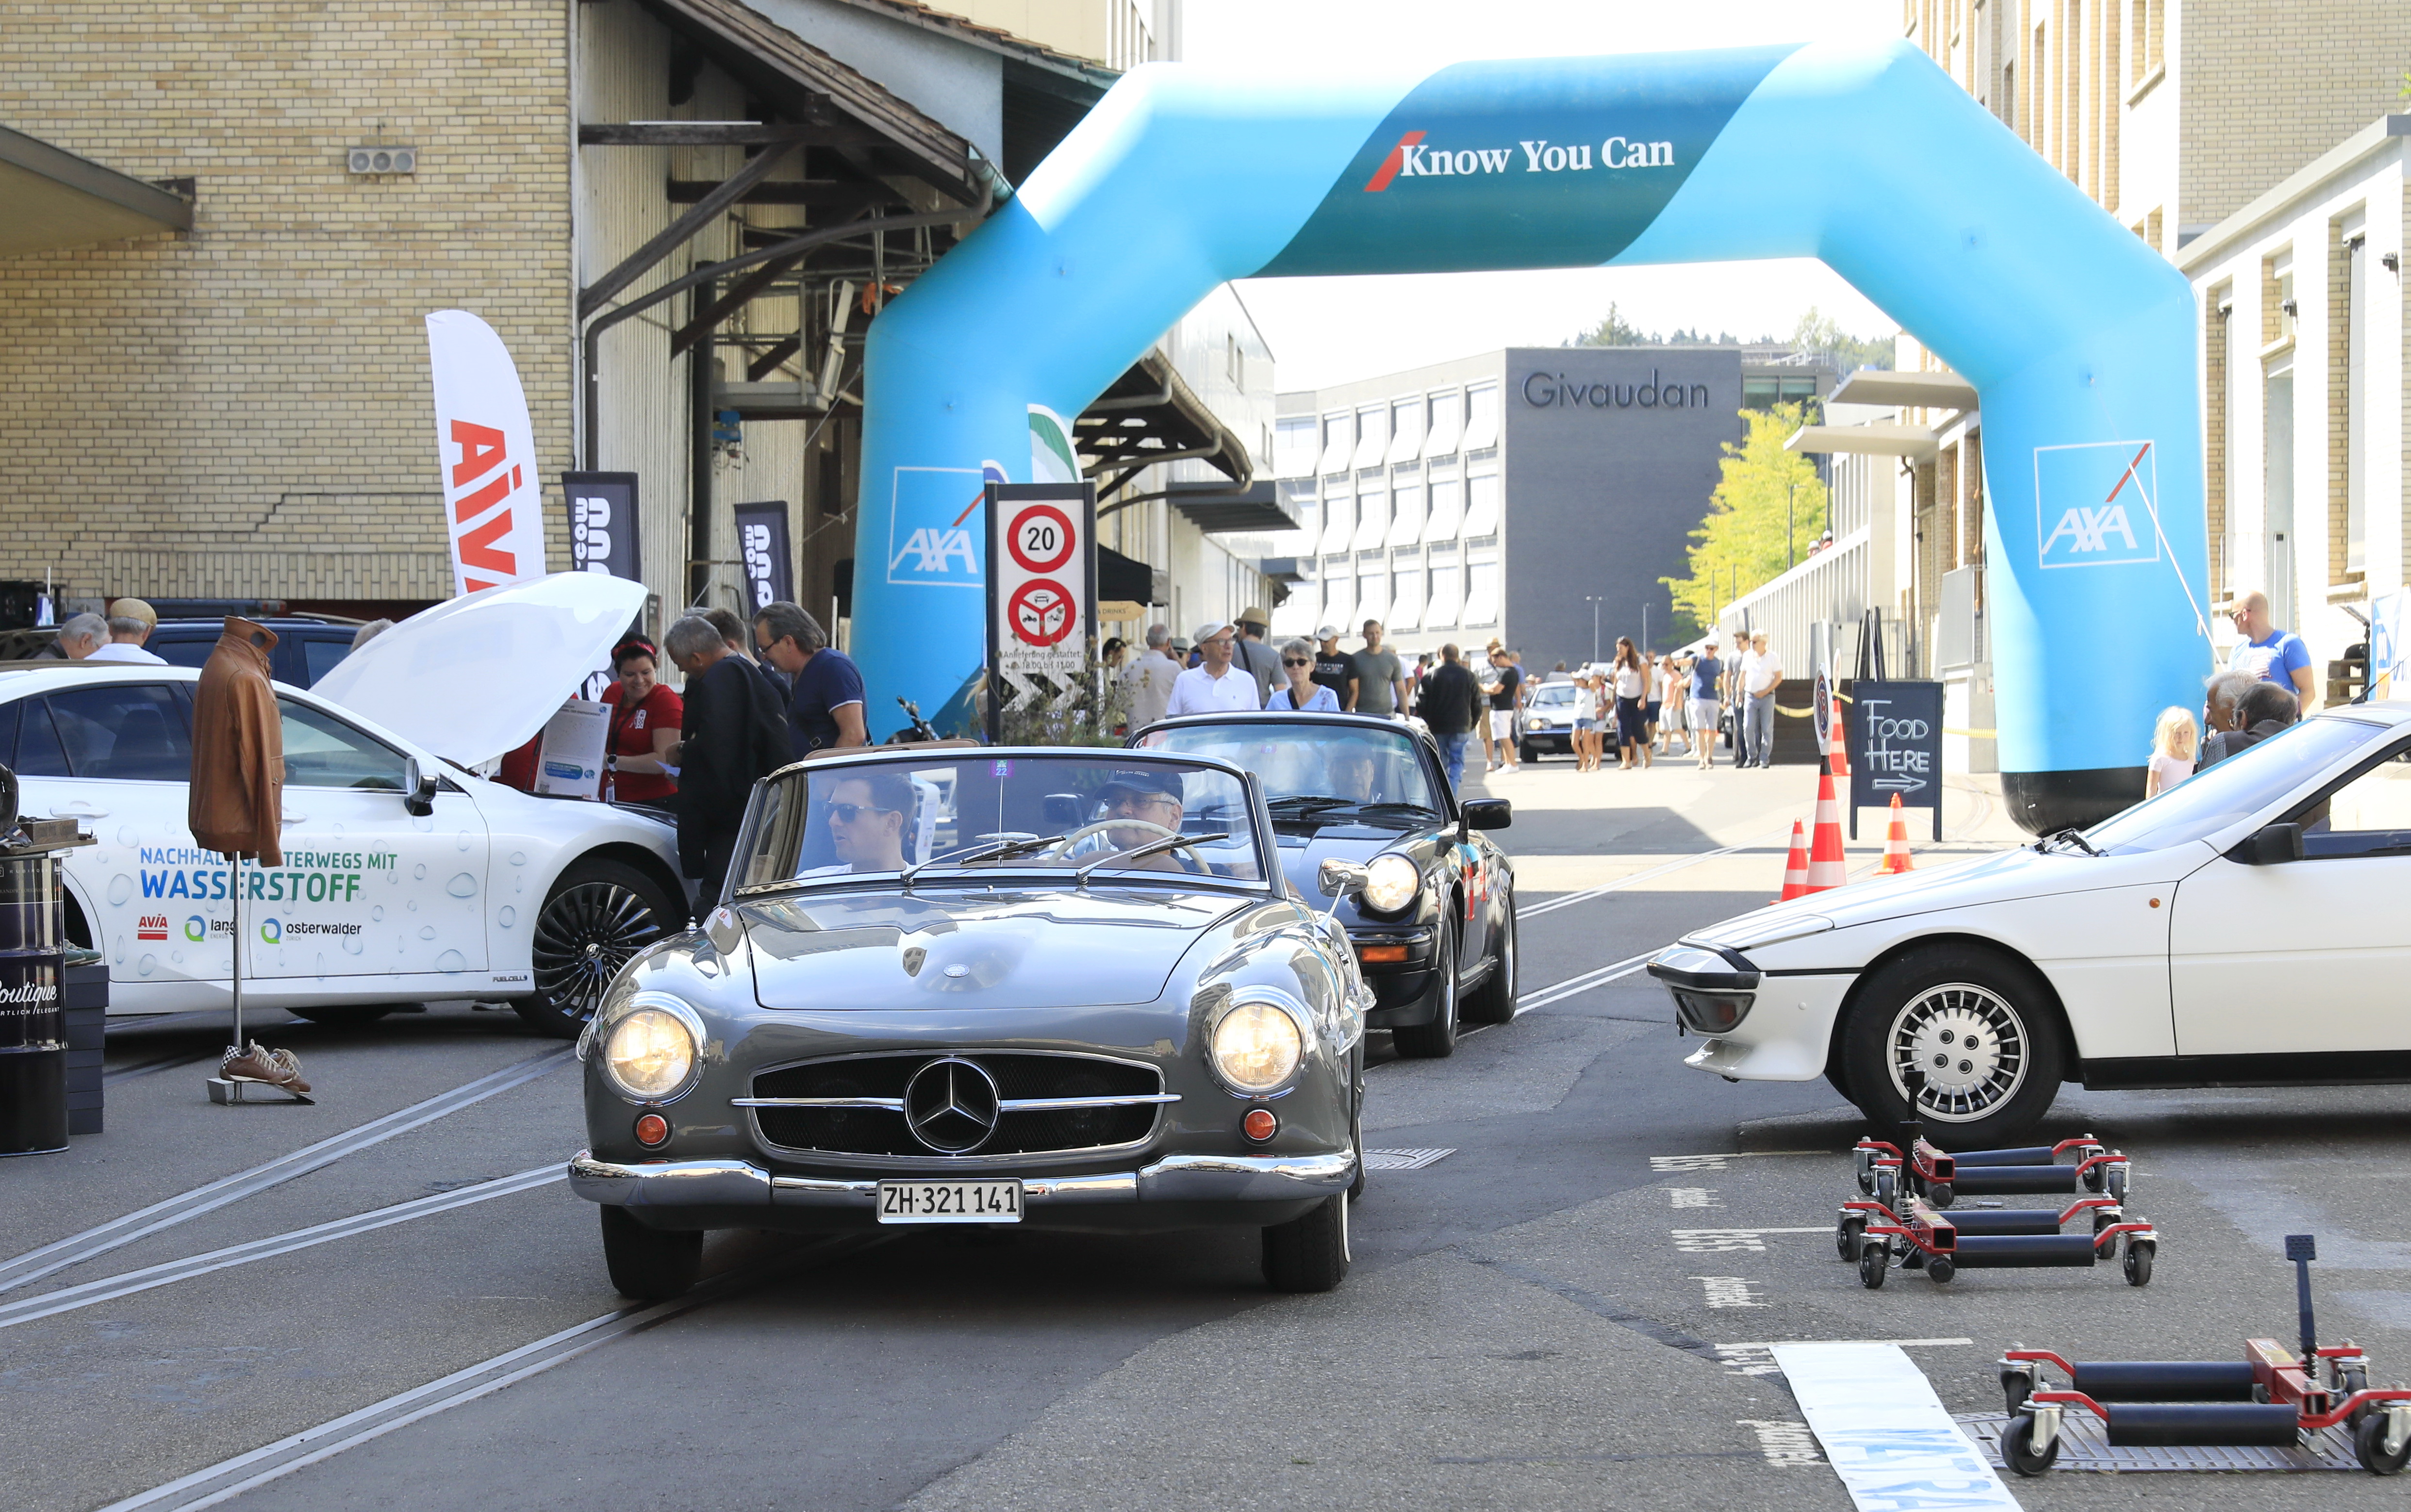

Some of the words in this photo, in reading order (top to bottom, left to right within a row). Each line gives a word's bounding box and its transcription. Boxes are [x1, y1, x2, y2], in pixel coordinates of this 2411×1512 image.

[1400, 144, 1512, 177] Know
[1519, 140, 1592, 172] You
[1602, 136, 1675, 169] Can
[1521, 368, 1709, 409] Givaudan
[1027, 527, 1055, 551] 20
[2041, 505, 2138, 555] AXA
[890, 527, 977, 574] AXA
[996, 767, 1007, 776] 22
[367, 853, 398, 870] MIT
[141, 869, 361, 902] WASSERSTOFF
[286, 922, 362, 935] osterwalder
[37, 1006, 59, 1015] ELEGANT
